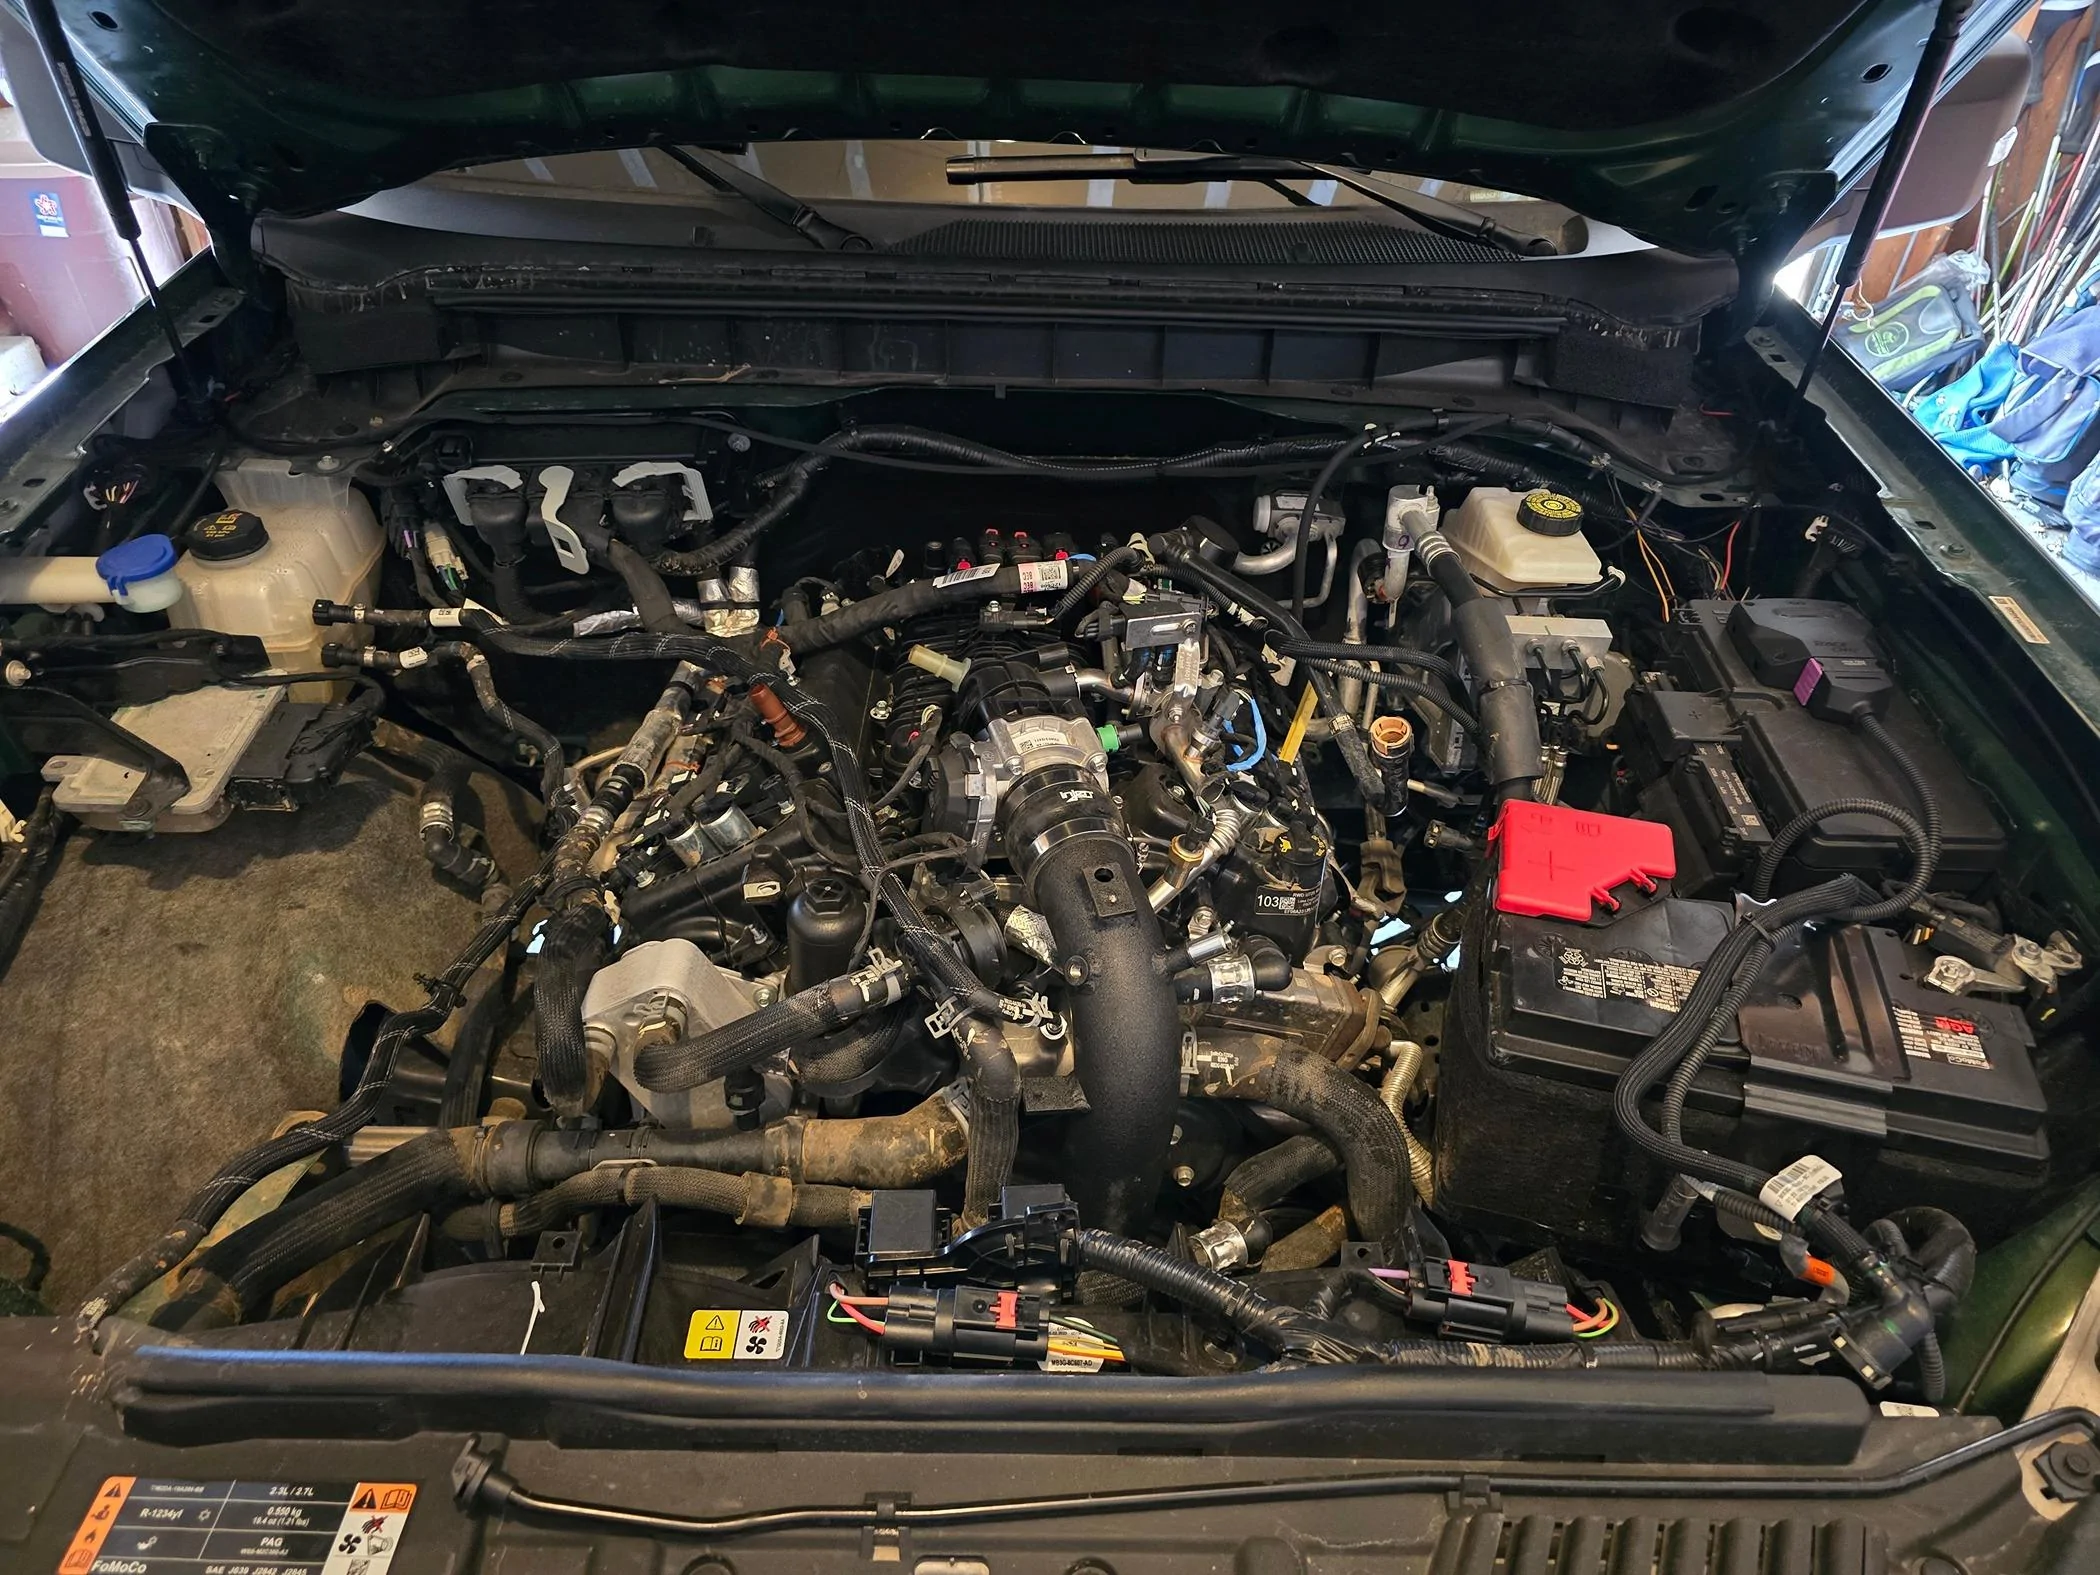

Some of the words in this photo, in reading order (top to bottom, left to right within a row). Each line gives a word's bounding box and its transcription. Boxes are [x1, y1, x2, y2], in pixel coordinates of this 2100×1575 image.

[1257, 894, 1280, 908] 103
[295, 1486, 315, 1496] 2.7L
[139, 1507, 184, 1521] R-1234yf
[291, 1506, 303, 1518] kg
[260, 1537, 284, 1547] PAG
[91, 1559, 148, 1574] FoMoCo
